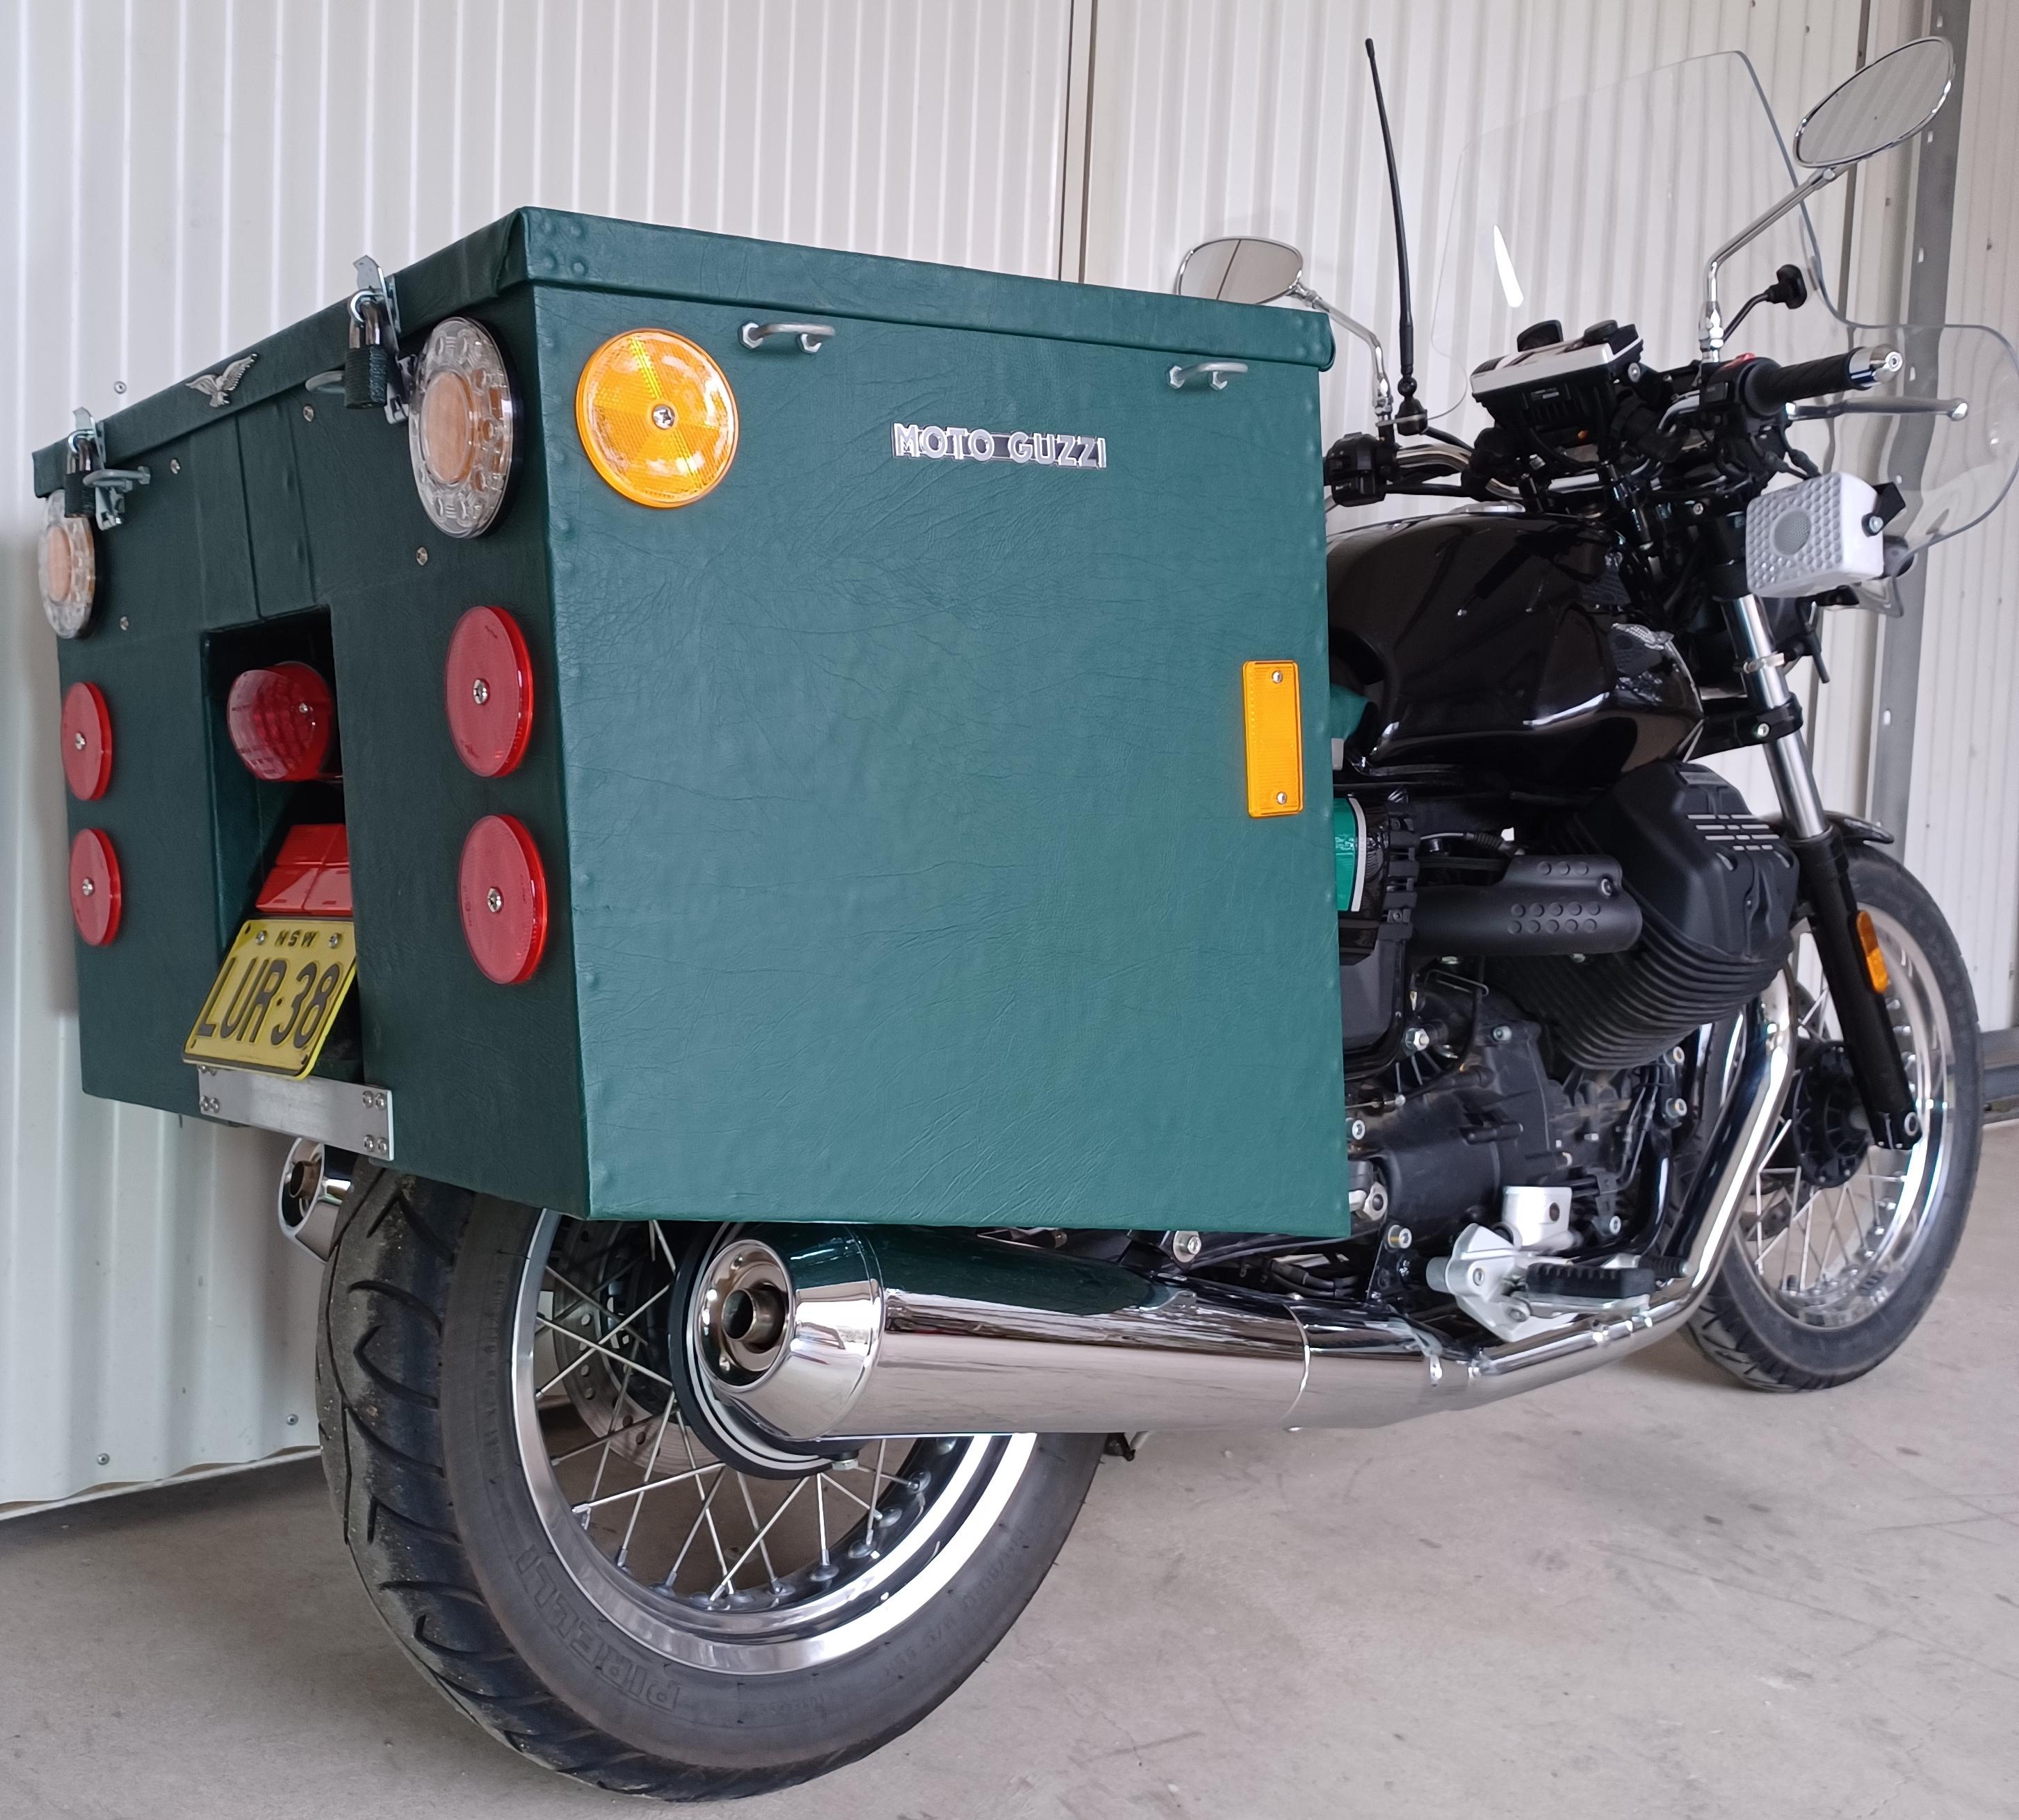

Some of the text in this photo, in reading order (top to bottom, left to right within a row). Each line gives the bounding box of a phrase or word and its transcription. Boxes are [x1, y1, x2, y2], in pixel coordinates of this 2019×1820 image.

[893, 423, 1107, 469] MOTO GUZZI
[275, 929, 318, 948] NSW
[514, 1545, 681, 1712] PIRELLI
